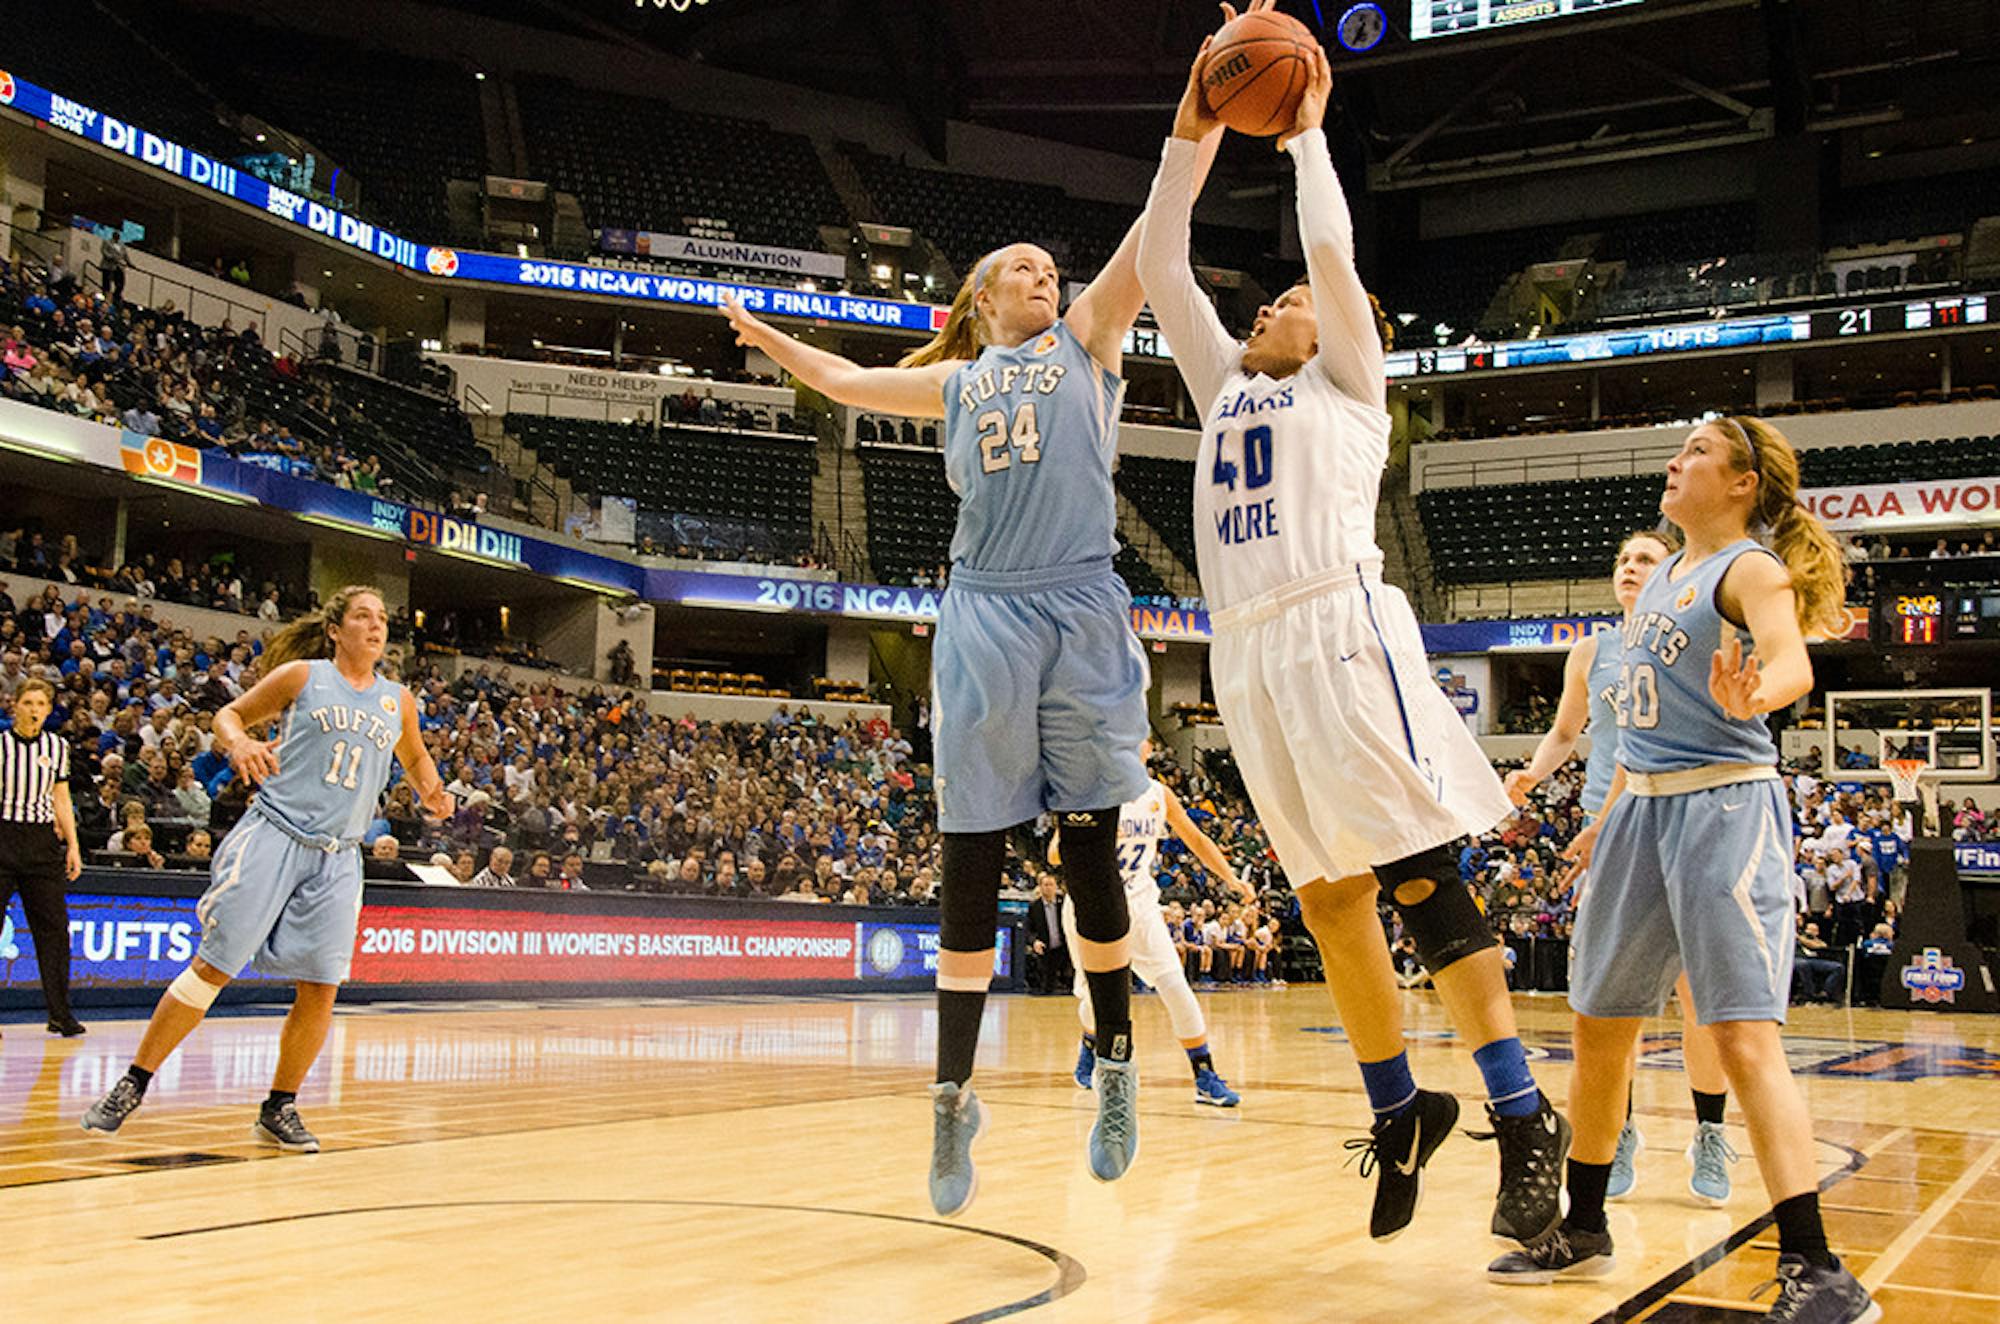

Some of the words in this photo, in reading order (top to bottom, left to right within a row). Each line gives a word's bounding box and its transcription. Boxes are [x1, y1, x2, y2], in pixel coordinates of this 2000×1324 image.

[1495, 4, 1556, 22] ASSISTS
[49, 111, 84, 136] 2016
[50, 93, 98, 127] INDY
[102, 115, 137, 156] DI
[142, 132, 183, 176] DII
[189, 152, 237, 197] DIII
[308, 201, 337, 237] DI
[340, 215, 374, 251] DII
[378, 230, 418, 269] DIII
[519, 262, 576, 288] 2016
[580, 269, 650, 296] NCAA
[773, 293, 838, 318] FINAL
[840, 301, 901, 324] FOUR
[1838, 308, 1872, 334] 21
[1938, 307, 1960, 324] 11
[1136, 338, 1155, 356] 14
[1650, 326, 1720, 350] TUFTS
[1420, 355, 1434, 374] 3
[1473, 353, 1485, 369] 4
[567, 373, 608, 388] NEED
[611, 377, 657, 392] HELP?
[960, 363, 1068, 415] TUFTS
[977, 401, 1041, 475] 24
[1212, 424, 1273, 491] 40
[371, 500, 407, 521] INDY
[372, 517, 402, 532] 2016
[1214, 498, 1279, 545] MORE
[410, 511, 437, 545] DI
[441, 518, 477, 554] DII
[480, 528, 522, 562] DIII
[756, 580, 835, 611] 2016
[843, 587, 939, 616] NCAA
[1130, 609, 1205, 636] INAL
[1509, 624, 1547, 637] INDY
[309, 704, 393, 752] TUFTS
[321, 738, 364, 791] 11
[68, 920, 194, 962] TUFTS
[361, 927, 415, 954] 2016
[421, 928, 518, 955] DIVISION
[522, 932, 542, 955] III
[546, 933, 635, 956] WOMEN'S
[638, 934, 743, 957] BASKETBALL
[745, 935, 852, 959] CHAMPIONSHIP
